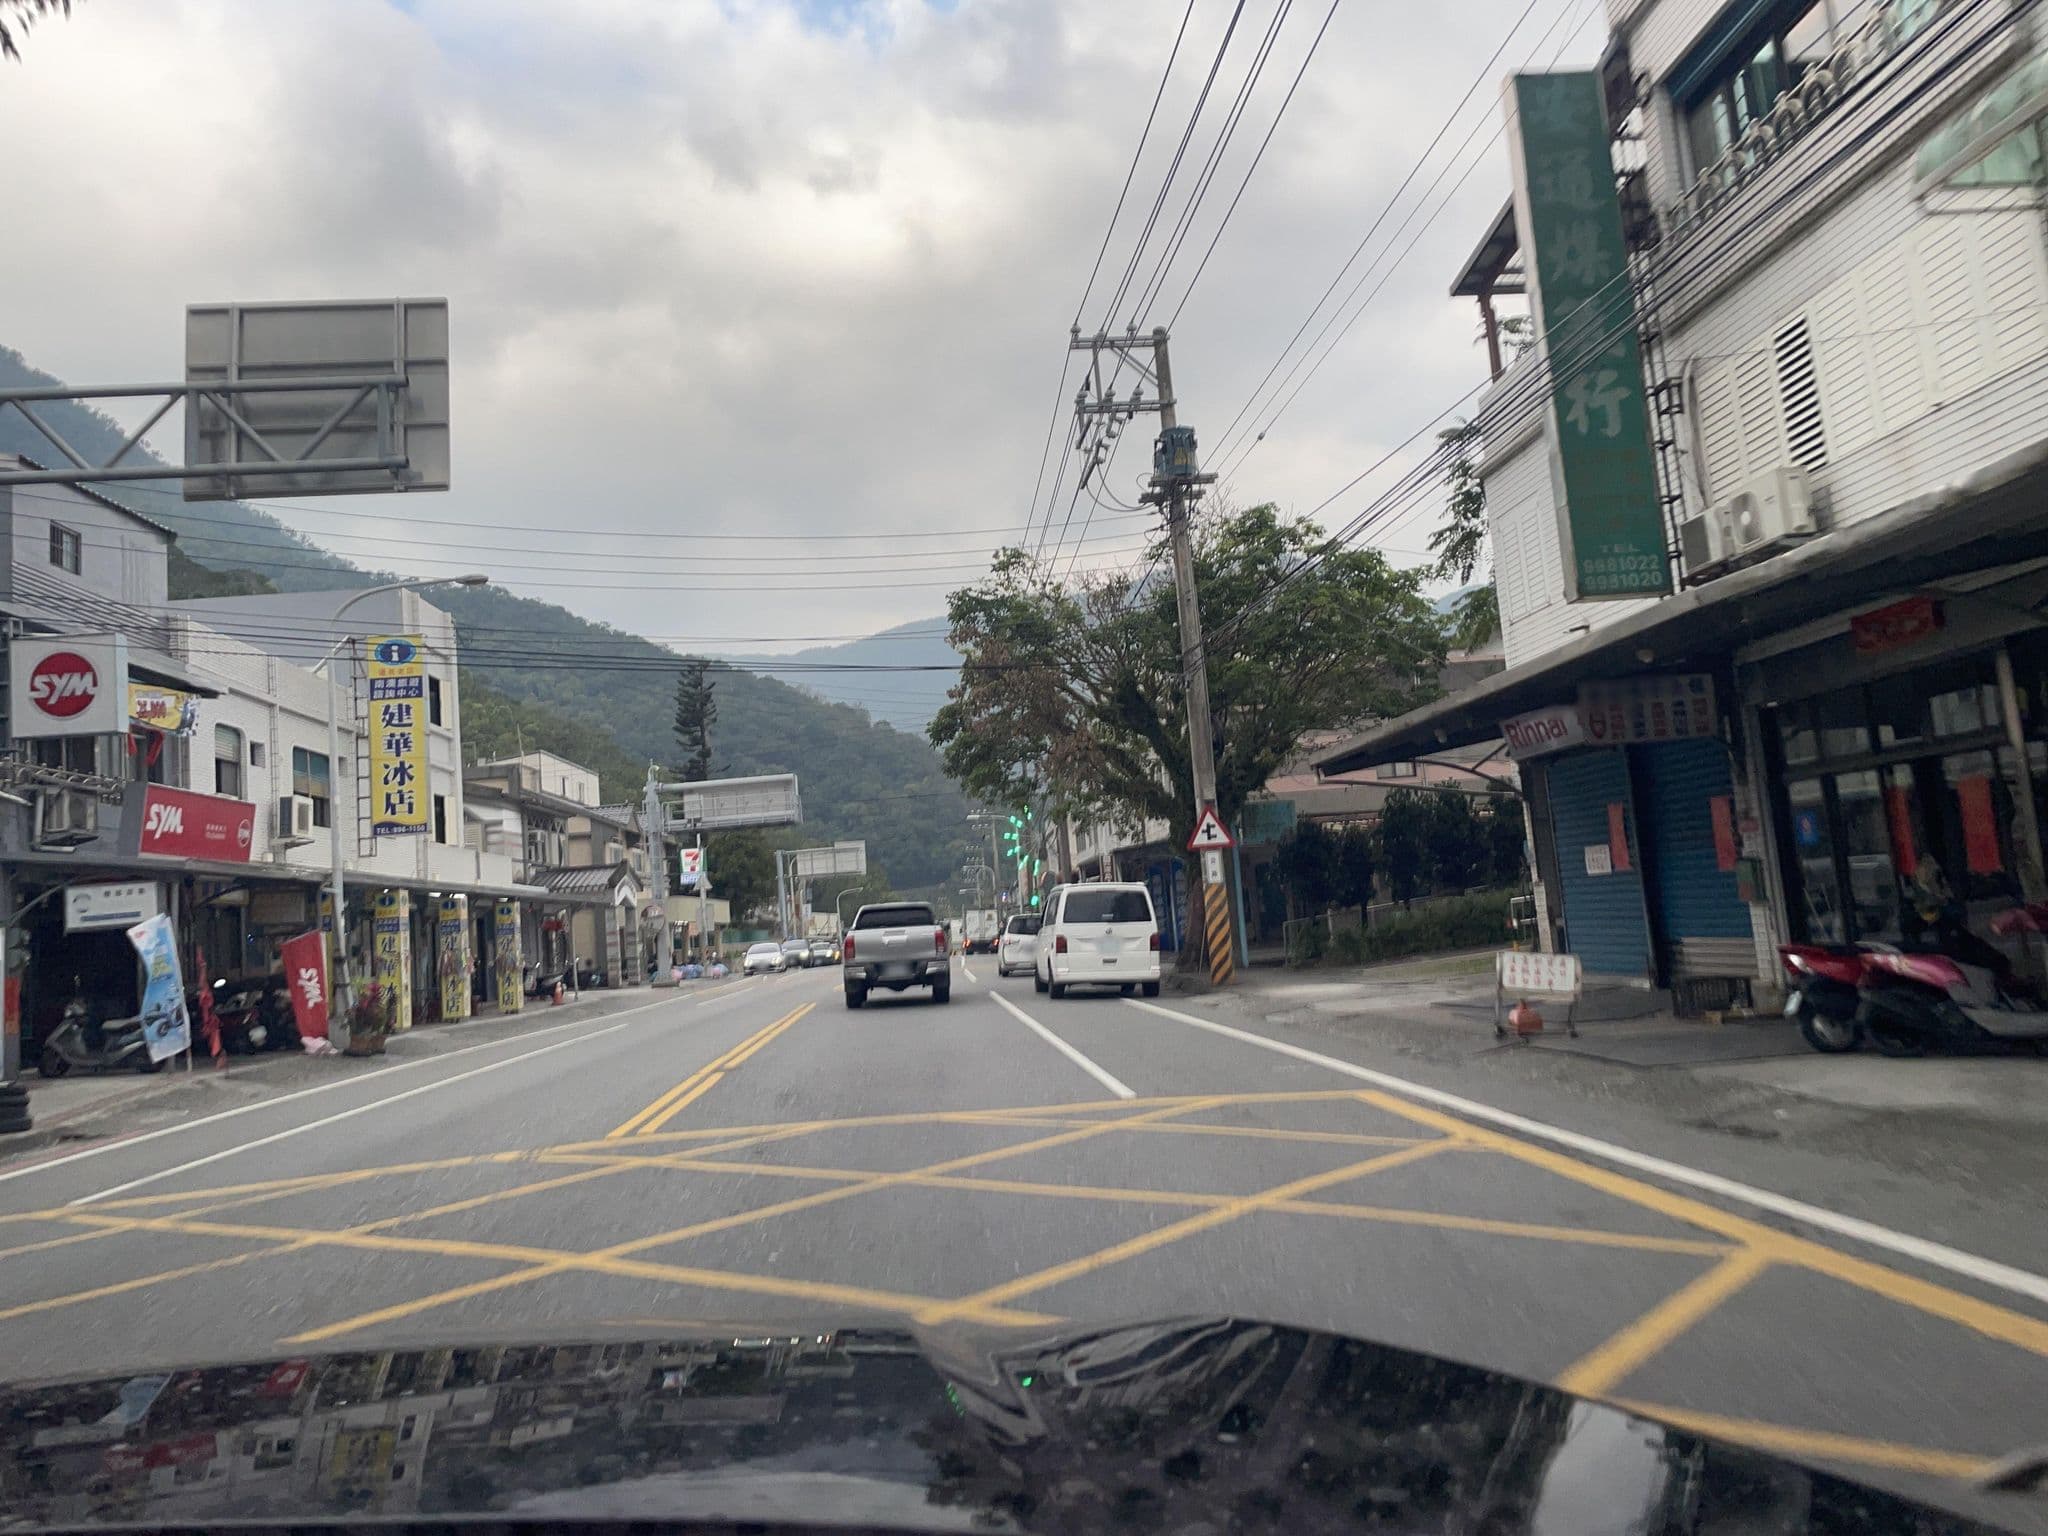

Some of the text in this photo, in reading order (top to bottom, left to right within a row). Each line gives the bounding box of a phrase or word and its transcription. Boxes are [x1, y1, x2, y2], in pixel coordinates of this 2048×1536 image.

[29, 671, 96, 705] SYM
[1504, 717, 1569, 750] Rinnai
[381, 703, 415, 816] 建華冰店
[144, 802, 184, 840] SYM
[297, 967, 323, 1009] SYM
